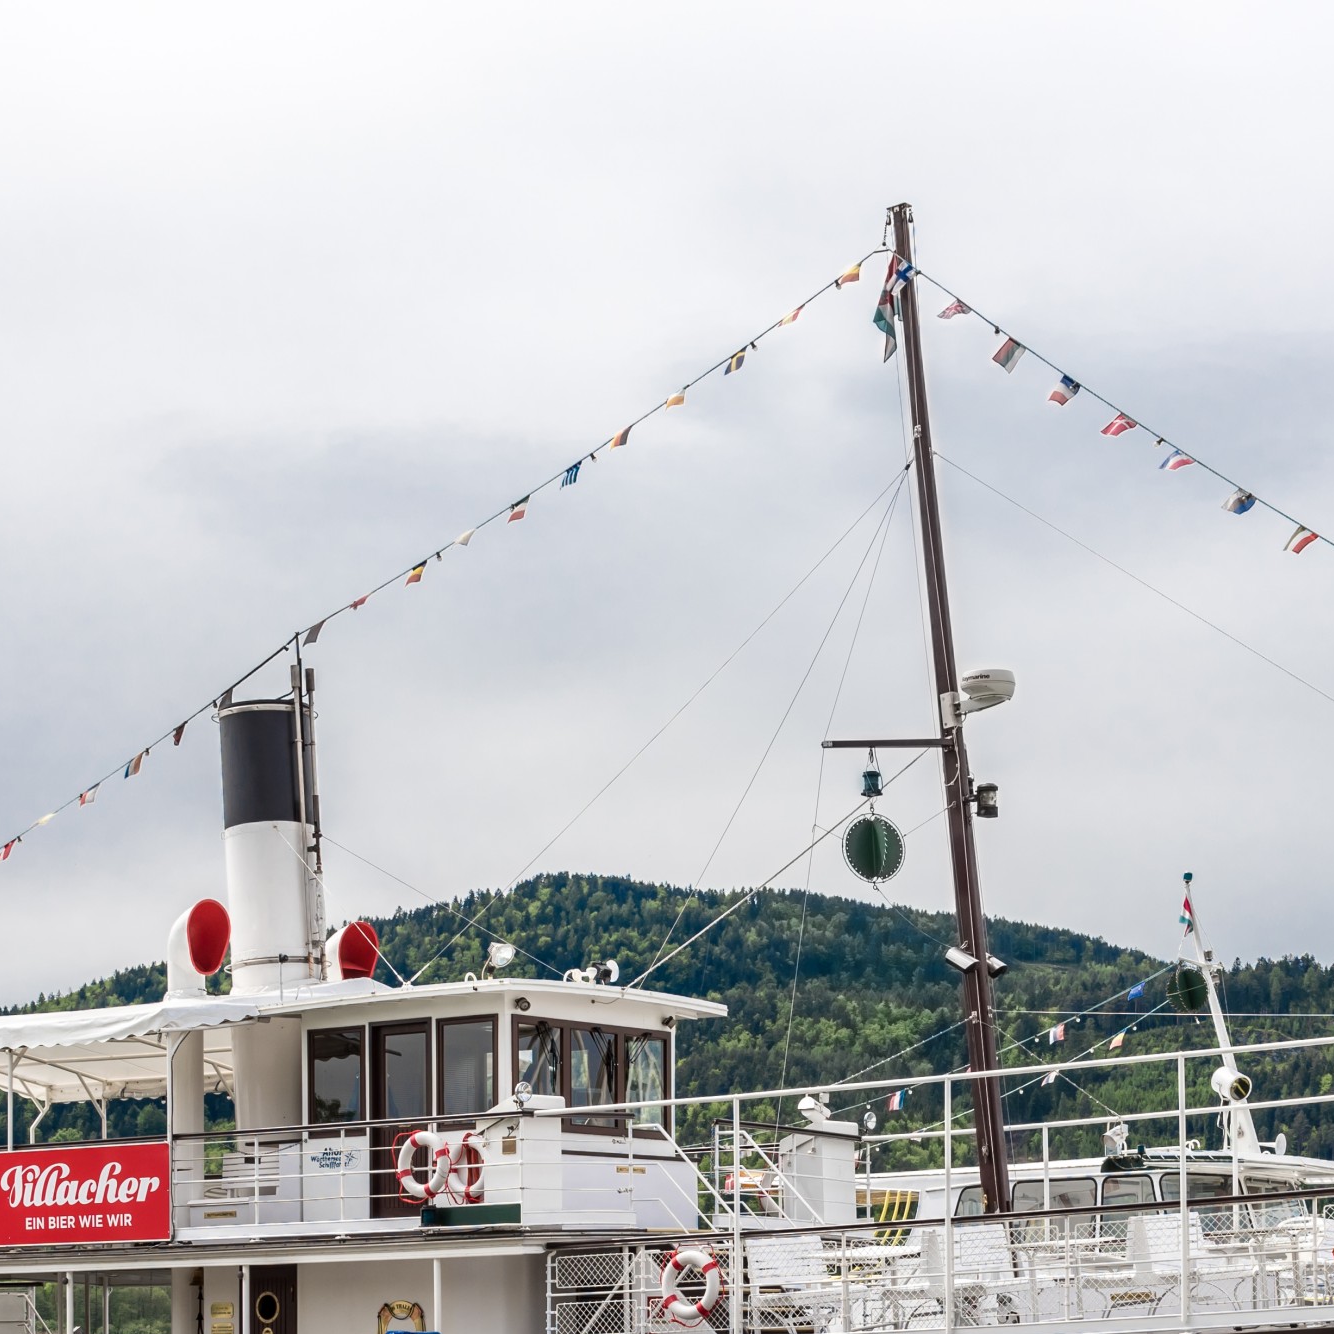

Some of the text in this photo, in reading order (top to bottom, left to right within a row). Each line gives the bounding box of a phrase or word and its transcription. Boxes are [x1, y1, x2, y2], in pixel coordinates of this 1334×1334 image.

[0, 1161, 160, 1208] Villacher
[25, 1213, 132, 1230] EIN BIER WIE WIR
